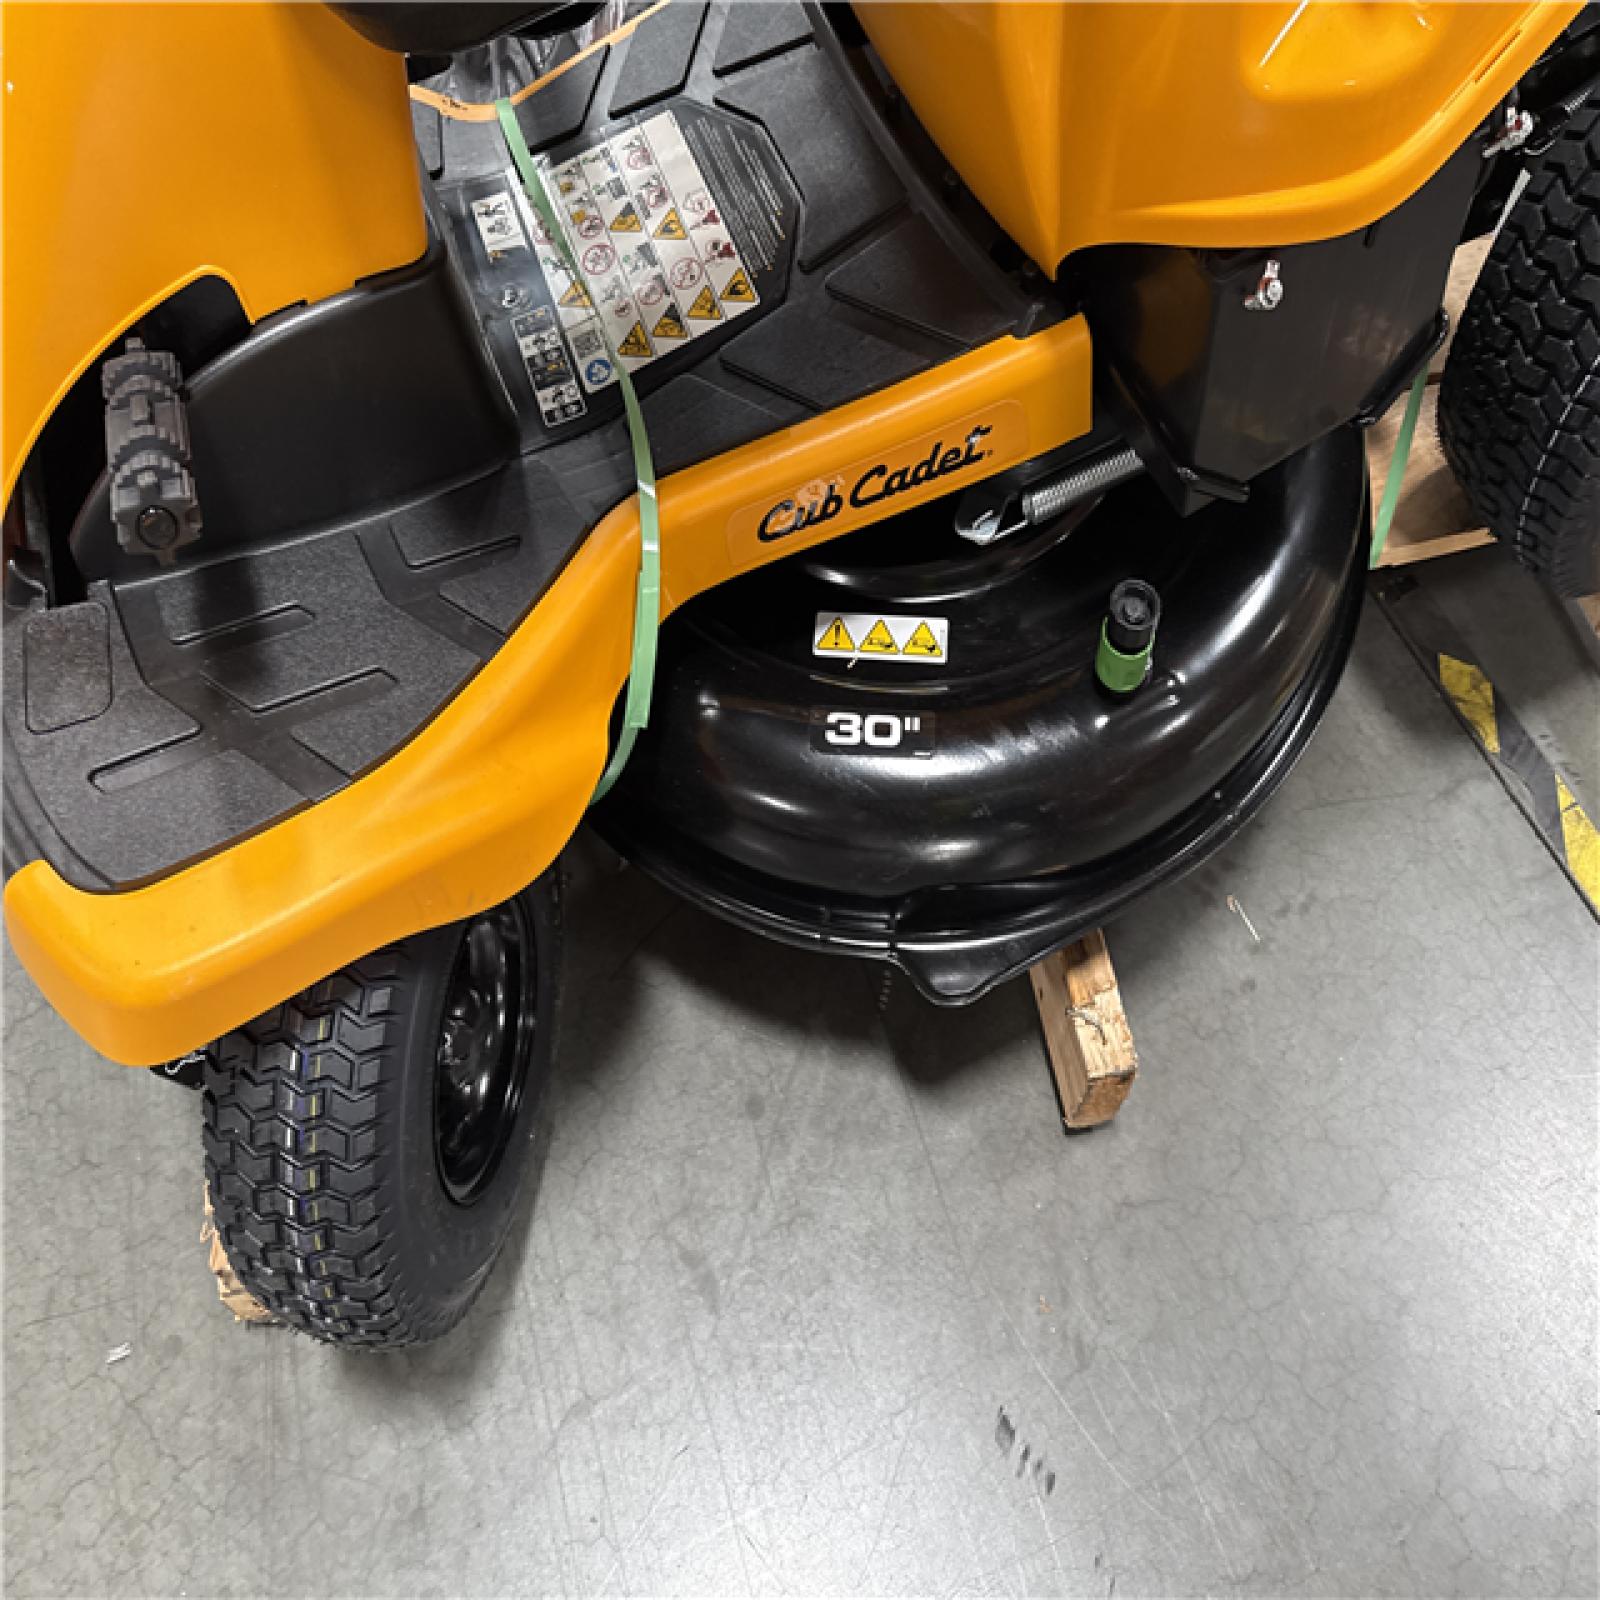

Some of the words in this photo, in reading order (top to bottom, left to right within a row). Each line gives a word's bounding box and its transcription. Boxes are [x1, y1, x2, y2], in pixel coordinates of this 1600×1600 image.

[757, 482, 844, 542] Cub
[850, 424, 993, 508] Cadet
[824, 711, 921, 747] 30"
